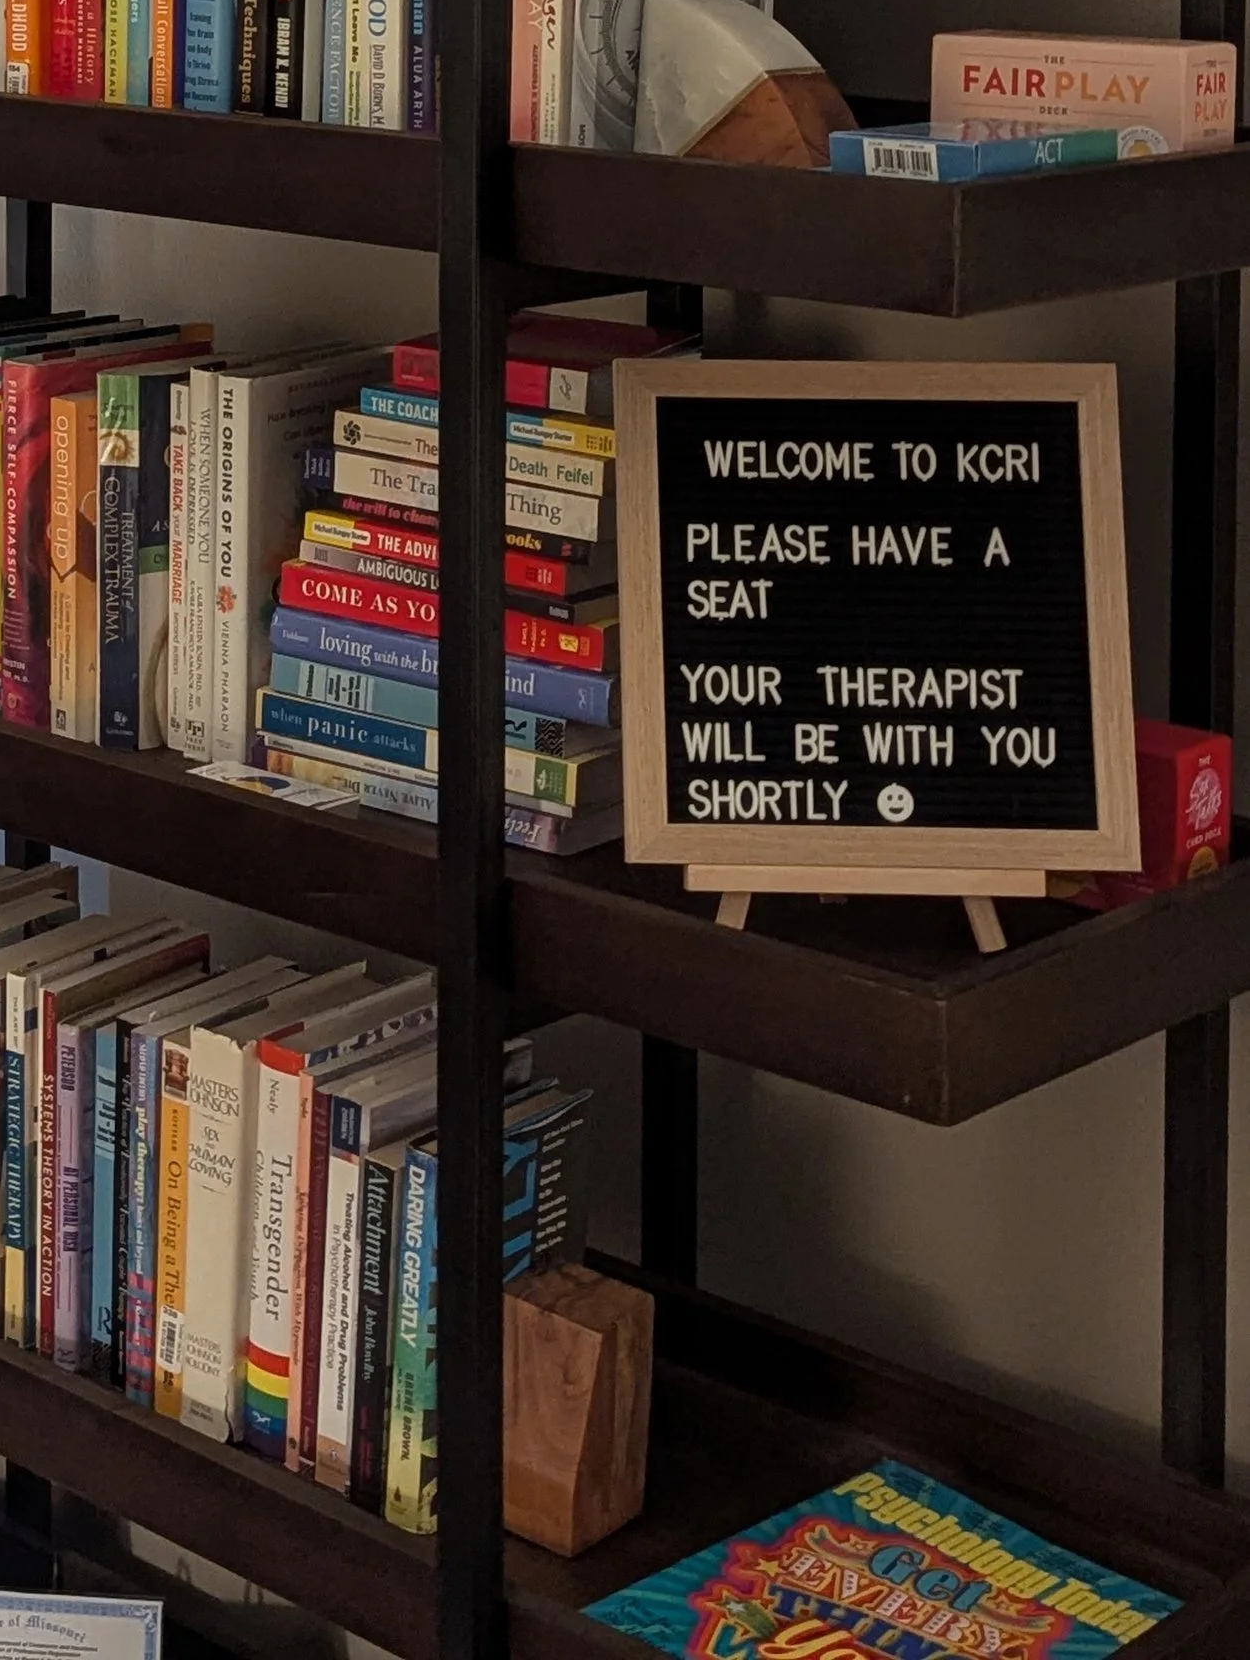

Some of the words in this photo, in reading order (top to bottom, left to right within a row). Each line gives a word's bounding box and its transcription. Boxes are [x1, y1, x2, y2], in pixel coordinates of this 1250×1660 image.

[351, 9, 359, 42] Leave
[109, 29, 118, 97] HACKMAN
[351, 45, 359, 64] Me
[963, 65, 1045, 97] FAIR
[1055, 75, 1150, 104] PLAY
[1196, 71, 1226, 96] FAIR
[1034, 139, 1064, 165] ACT
[7, 380, 17, 434] FIERCE
[223, 388, 234, 420] THE
[370, 397, 395, 415] THE
[397, 401, 439, 423] COACH
[53, 415, 69, 517] opening
[221, 428, 234, 504] ORIGINS
[508, 456, 548, 478] Death
[556, 466, 593, 486] Feifel
[703, 439, 874, 481] WELCOME
[891, 441, 937, 482] TO
[956, 442, 1041, 483] KCRI
[7, 443, 18, 600] SELF-COMPASSION
[104, 477, 121, 562] COMPLEX
[221, 511, 232, 534] OF
[507, 493, 562, 523] Thing
[53, 527, 69, 560] up
[220, 540, 232, 578] YOU
[686, 523, 831, 565] PLEASE
[852, 525, 953, 567] HAVE
[983, 526, 1011, 568] A
[357, 557, 428, 587] AMBIGUOUS
[104, 568, 120, 644] TRAUMA
[686, 577, 774, 622] SEAT
[221, 620, 229, 666] VIENNA
[221, 671, 229, 733] PHARAON
[680, 663, 783, 706] YOUR
[816, 664, 1024, 711] THERAPIST
[270, 707, 303, 726] when
[306, 713, 368, 745] panic
[373, 734, 416, 754] attacks
[681, 721, 766, 765] WILL
[794, 722, 840, 765] BE
[862, 721, 954, 767] WITH
[981, 725, 1057, 769] YOU
[686, 778, 848, 822] SHORTLY
[61, 1044, 76, 1092] PETERSON
[7, 1056, 21, 1158] STRATEGIC
[42, 1074, 54, 1143] SYSTEMS
[265, 1078, 280, 1114] Nealy
[7, 1160, 21, 1240] THERAPY
[41, 1146, 53, 1212] THEORY
[41, 1216, 52, 1231] IN
[406, 1164, 426, 1250] DARING
[262, 1154, 293, 1321] Transgender
[41, 1233, 53, 1297] ACTION
[399, 1251, 422, 1348] GREATLY
[832, 1471, 1057, 1595] Psychology
[782, 1548, 1004, 1655] EVERY
[868, 1544, 995, 1612] Get
[8, 1615, 21, 1628] of
[25, 1614, 87, 1643] Missouri
